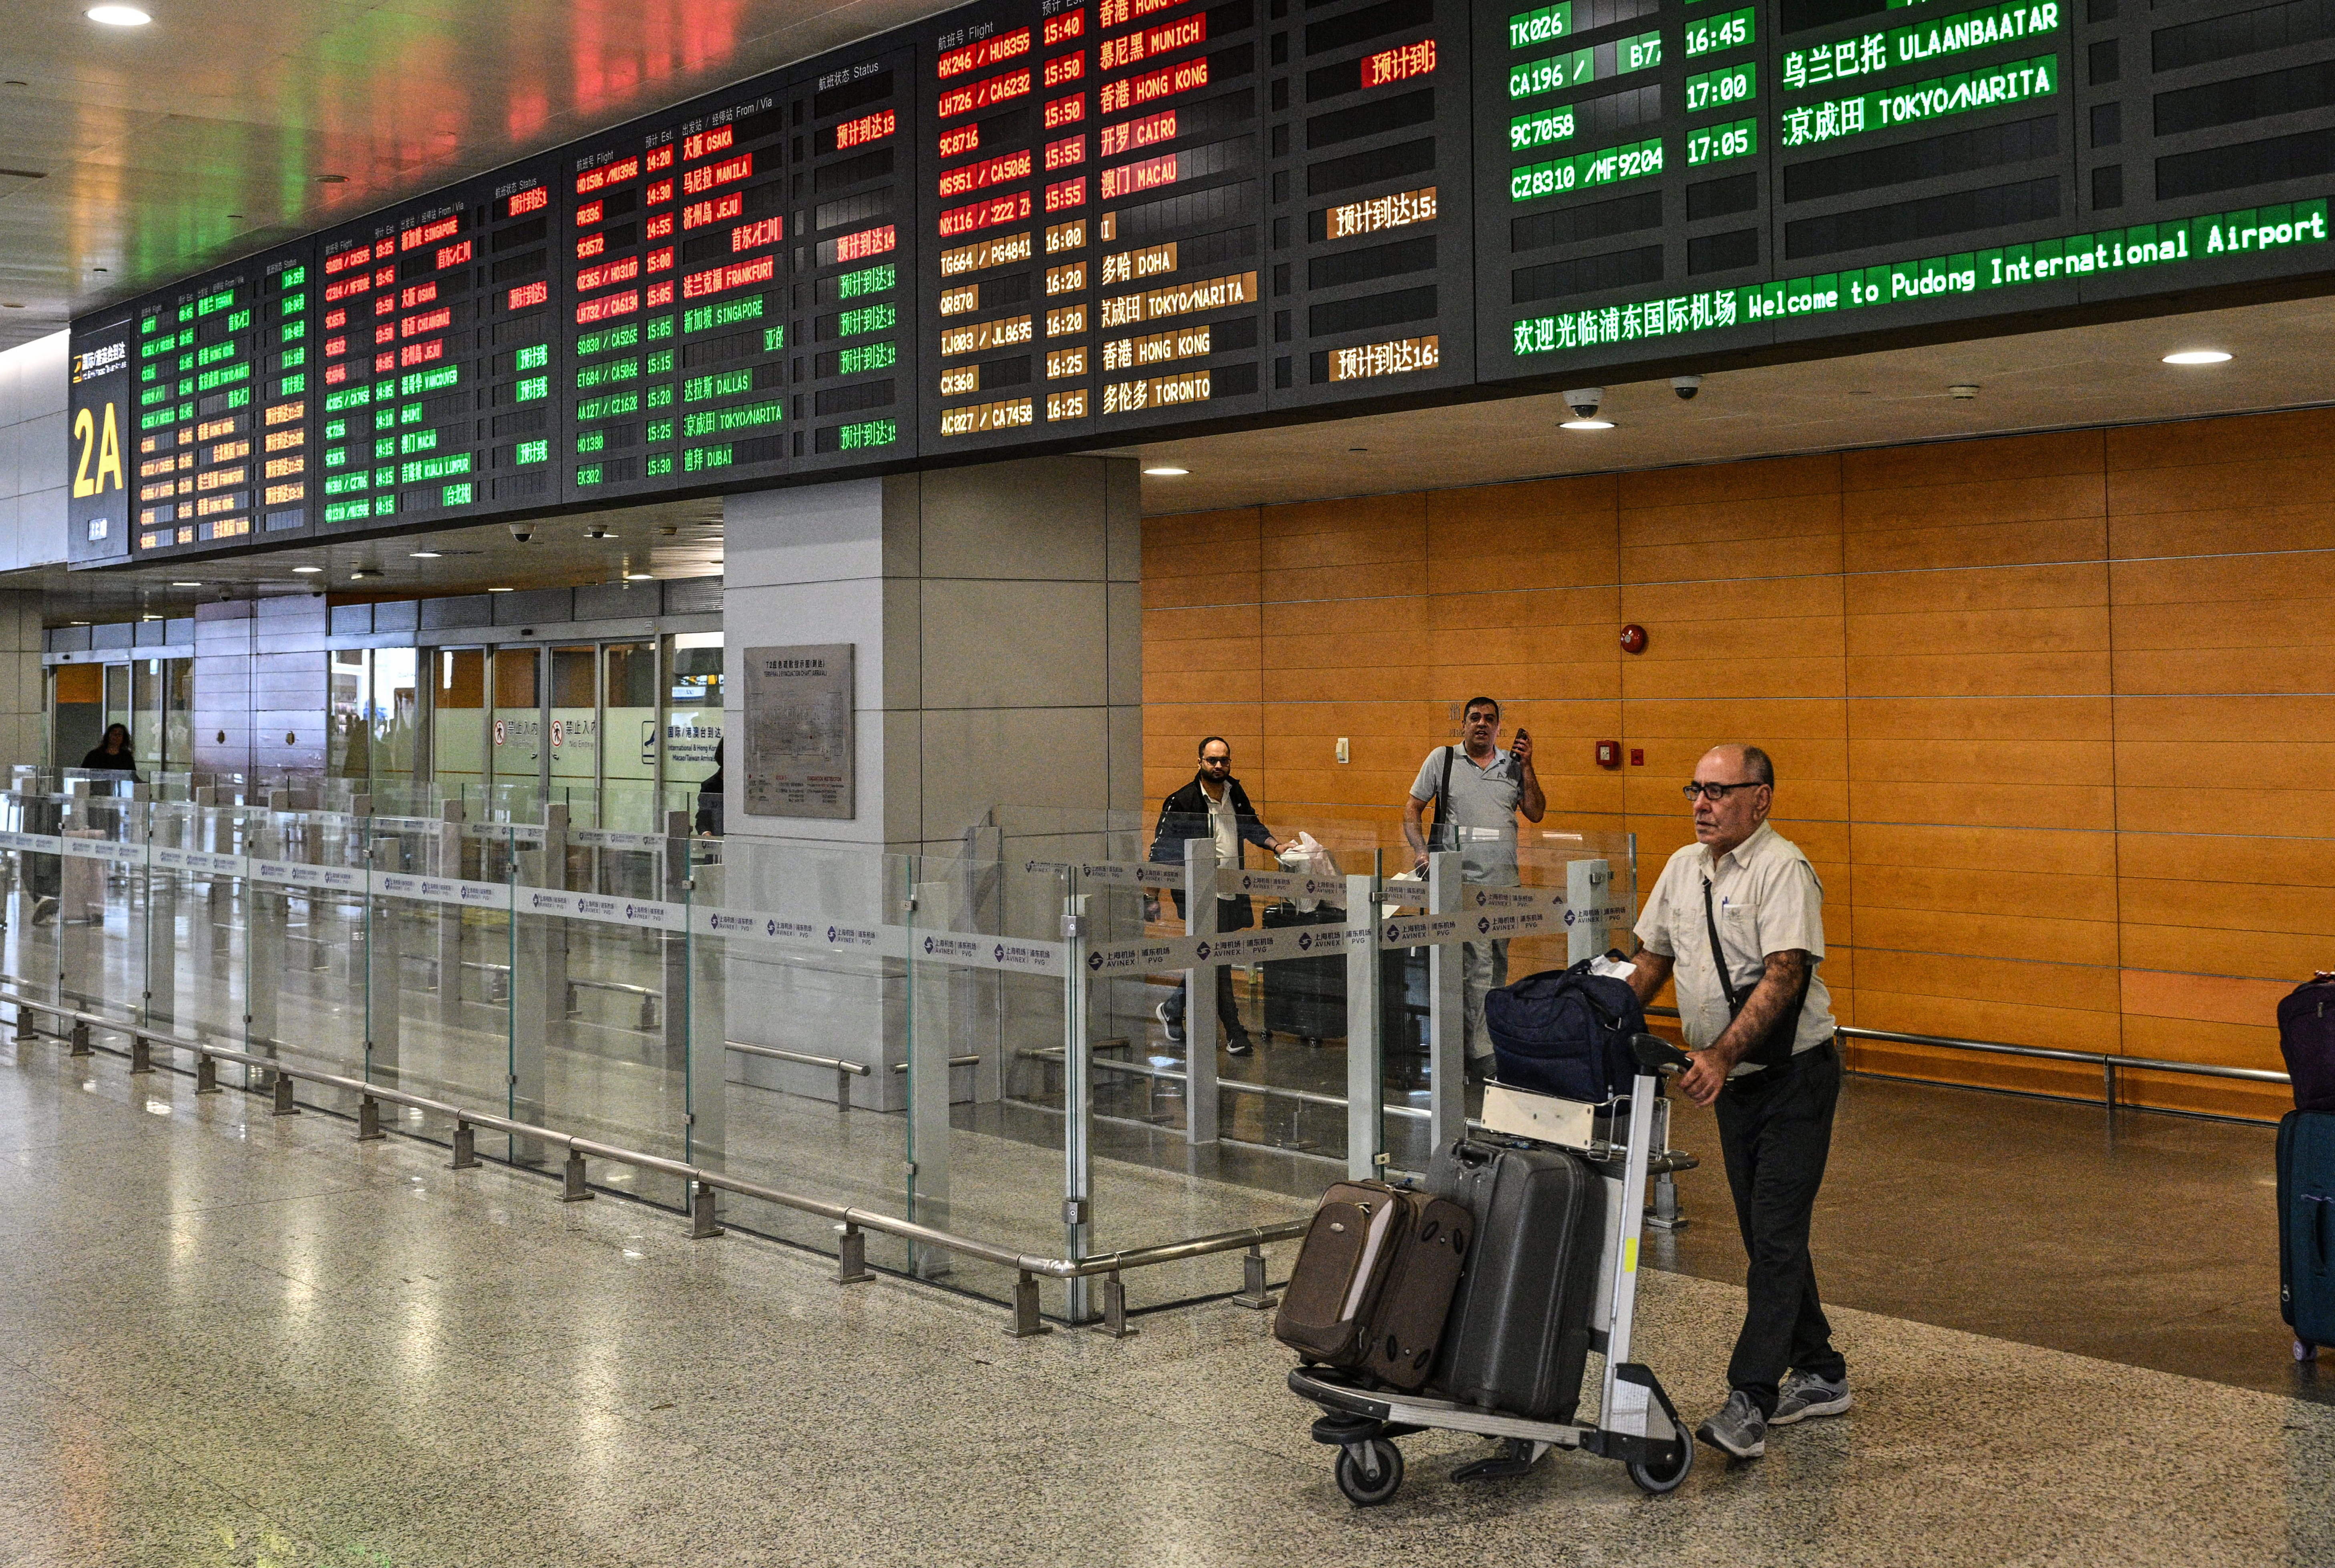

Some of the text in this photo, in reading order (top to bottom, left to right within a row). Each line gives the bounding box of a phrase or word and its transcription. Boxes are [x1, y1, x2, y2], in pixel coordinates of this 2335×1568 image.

[939, 21, 993, 51] 航班号 Flight
[1044, 20, 1079, 43] 15:40
[1510, 13, 1562, 46] TK026
[1687, 18, 1746, 54] 16:45
[1100, 22, 1199, 70] 慕尼黑 MUNICH
[1783, 2, 2057, 88] 乌兰巴托 ULAANBAATAR
[939, 51, 971, 76] HX246
[1044, 63, 1080, 85] 15:50
[819, 62, 879, 91] 航班状态 Status
[1510, 64, 1563, 96] CA196
[939, 74, 1030, 117] LH726 CA6232
[1100, 64, 1207, 113] 香港 HONG KONG
[1687, 74, 1746, 108] 17:00
[1880, 66, 2050, 124] TOKYO/NARITA
[682, 97, 772, 135] 出发站 经停站 From Via
[1045, 105, 1080, 127] 15:50
[646, 130, 674, 148] 预计 Est.
[1101, 119, 1176, 156] 开罗 CAIRO
[1510, 114, 1574, 147] 9C7058
[684, 130, 732, 160] 大阪 OSAKA
[939, 131, 978, 156] 9C8716
[1688, 129, 1748, 164] 17:05
[577, 150, 613, 171] 航班号 Flight
[647, 151, 670, 171] 14:20
[1045, 146, 1080, 168] 15:55
[519, 178, 537, 190] Status
[577, 172, 603, 193] HO1506
[684, 161, 747, 194] 马尼拉 MANILA
[940, 171, 972, 196] MS951
[1101, 163, 1177, 199] 澳门 MACAU
[1511, 165, 1575, 198] CZ8310
[647, 184, 670, 204] 14:30
[1046, 188, 1081, 210] 15:55
[577, 206, 599, 225] PR336
[684, 199, 738, 229] 济州岛 JEJU
[940, 212, 973, 236] NX116
[424, 220, 458, 242] SINGAPORE
[647, 219, 671, 238] 14:55
[732, 217, 778, 253] 首尔/仁川
[376, 241, 394, 258] 13:25
[577, 238, 604, 257] 9C8572
[1046, 229, 1081, 252] 16:00
[647, 253, 671, 271] 15:00
[941, 239, 1031, 275] TG664 PG4841
[1102, 251, 1170, 285] 多哈 DOHA
[577, 261, 638, 289] OZ365 HO3107
[684, 261, 773, 298] 法兰克福 FRANKFURT
[1046, 271, 1082, 293] 16:20
[1514, 212, 2326, 355] 欢迎光临浦东国际机场 Welcome to Pudong International Airport
[417, 285, 436, 303] OSAKA
[648, 287, 671, 306] 15:05
[940, 291, 973, 314] QR870
[1149, 282, 1244, 316] TOKYO/NARITA
[577, 294, 638, 322] LH732 CA6134
[684, 301, 762, 333] 新加坡 SINGAPORE
[417, 312, 450, 332] CHIANGMAI
[1046, 314, 1082, 336] 16:20
[577, 338, 599, 354] SQ830
[941, 321, 1032, 355] IJ003 JL8695
[425, 344, 440, 359] JEJU
[1103, 331, 1210, 371] 香港 HONG KONG
[1047, 356, 1082, 378] 16:25
[425, 370, 458, 389] VANCOUVER
[577, 370, 599, 387] ET684
[684, 376, 748, 402] 达拉斯 DALLAS
[941, 372, 973, 394] CX360
[648, 390, 671, 406] 15:20
[1104, 378, 1210, 414] 多伦多 TORONTO
[578, 403, 599, 420] AA127
[720, 406, 782, 430] TOKYO/NARITA
[941, 404, 1032, 435] AC027 CA7458
[1047, 398, 1082, 419] 16:25
[376, 413, 393, 428] 14:10
[74, 402, 123, 498] 2A
[376, 442, 393, 457] 14:15
[417, 433, 436, 450] MACAU
[577, 435, 603, 453] HO1380
[425, 458, 469, 476] KUALA LUMPUR
[648, 458, 671, 475] 15:30
[684, 448, 732, 472] 迪拜 DUBAI
[577, 469, 599, 485] EK302
[668, 726, 721, 738] 国际/港澳台到达
[1214, 937, 1273, 950] 上海机场 浦东机场
[1315, 929, 1371, 941] 上海机场 浦东机场
[1315, 940, 1340, 948] AVINEX
[1106, 959, 1135, 968] AVINEX
[1107, 947, 1170, 960] 上海机场 浦东机场
[1213, 949, 1241, 957] AVINEX
